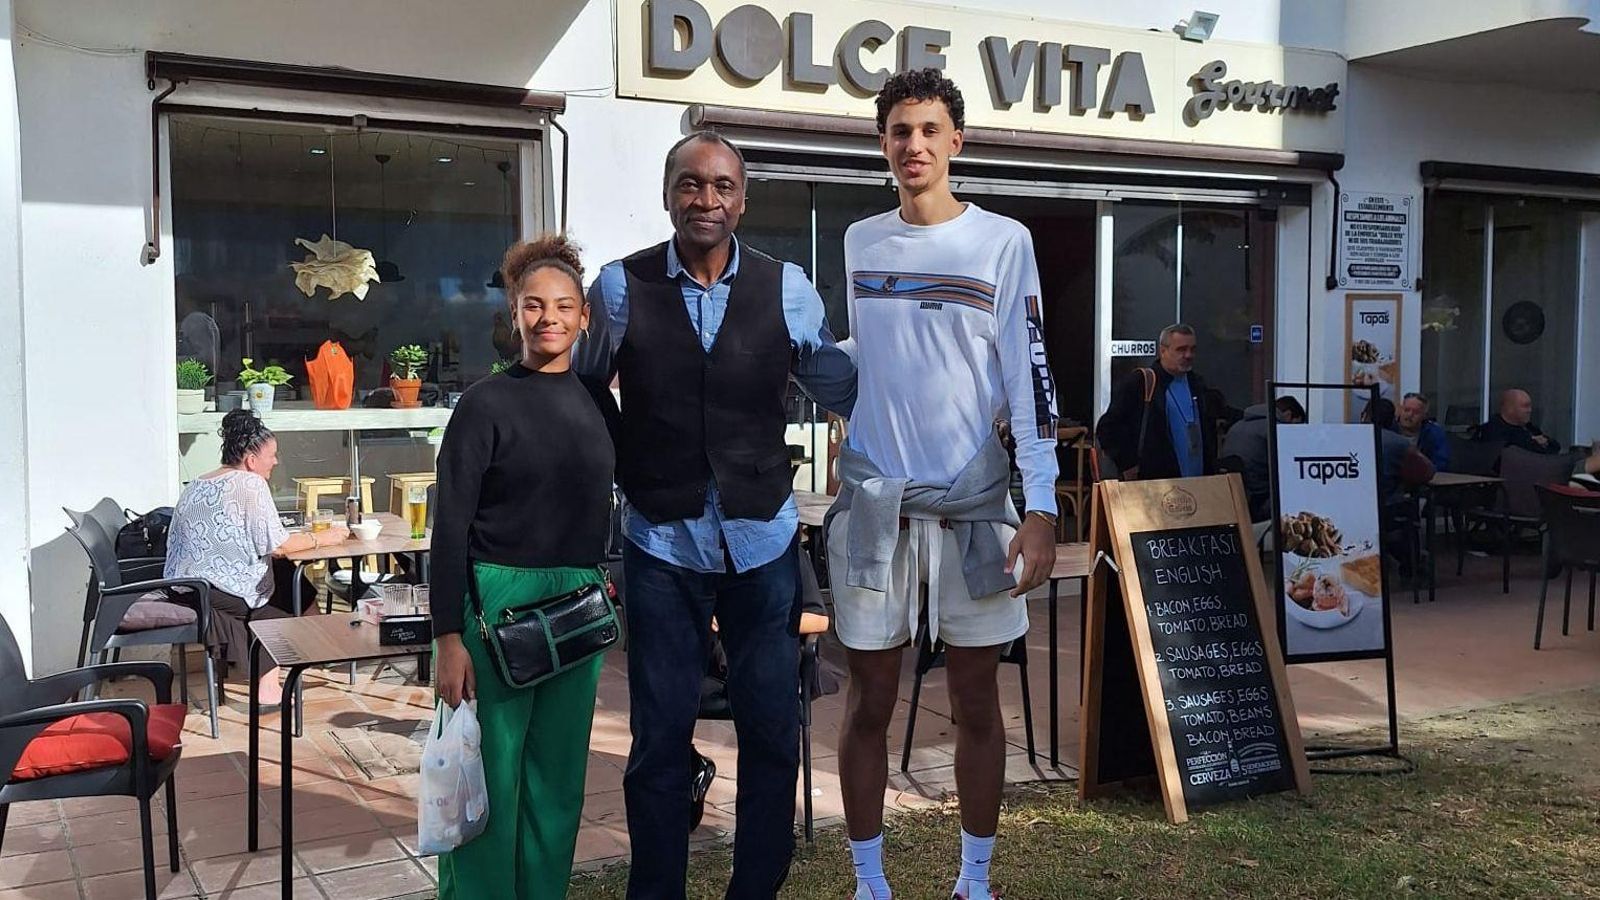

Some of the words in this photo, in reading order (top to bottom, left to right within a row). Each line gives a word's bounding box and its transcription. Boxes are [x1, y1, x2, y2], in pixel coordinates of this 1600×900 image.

[647, 0, 951, 98] DOLCE
[982, 35, 1156, 117] VITA
[1359, 310, 1390, 326] Tapas
[1111, 343, 1156, 355] CHURROS
[1294, 453, 1359, 485] Tapas
[1146, 533, 1237, 559] BREAKFAST
[1190, 768, 1232, 786] CERVEZA
